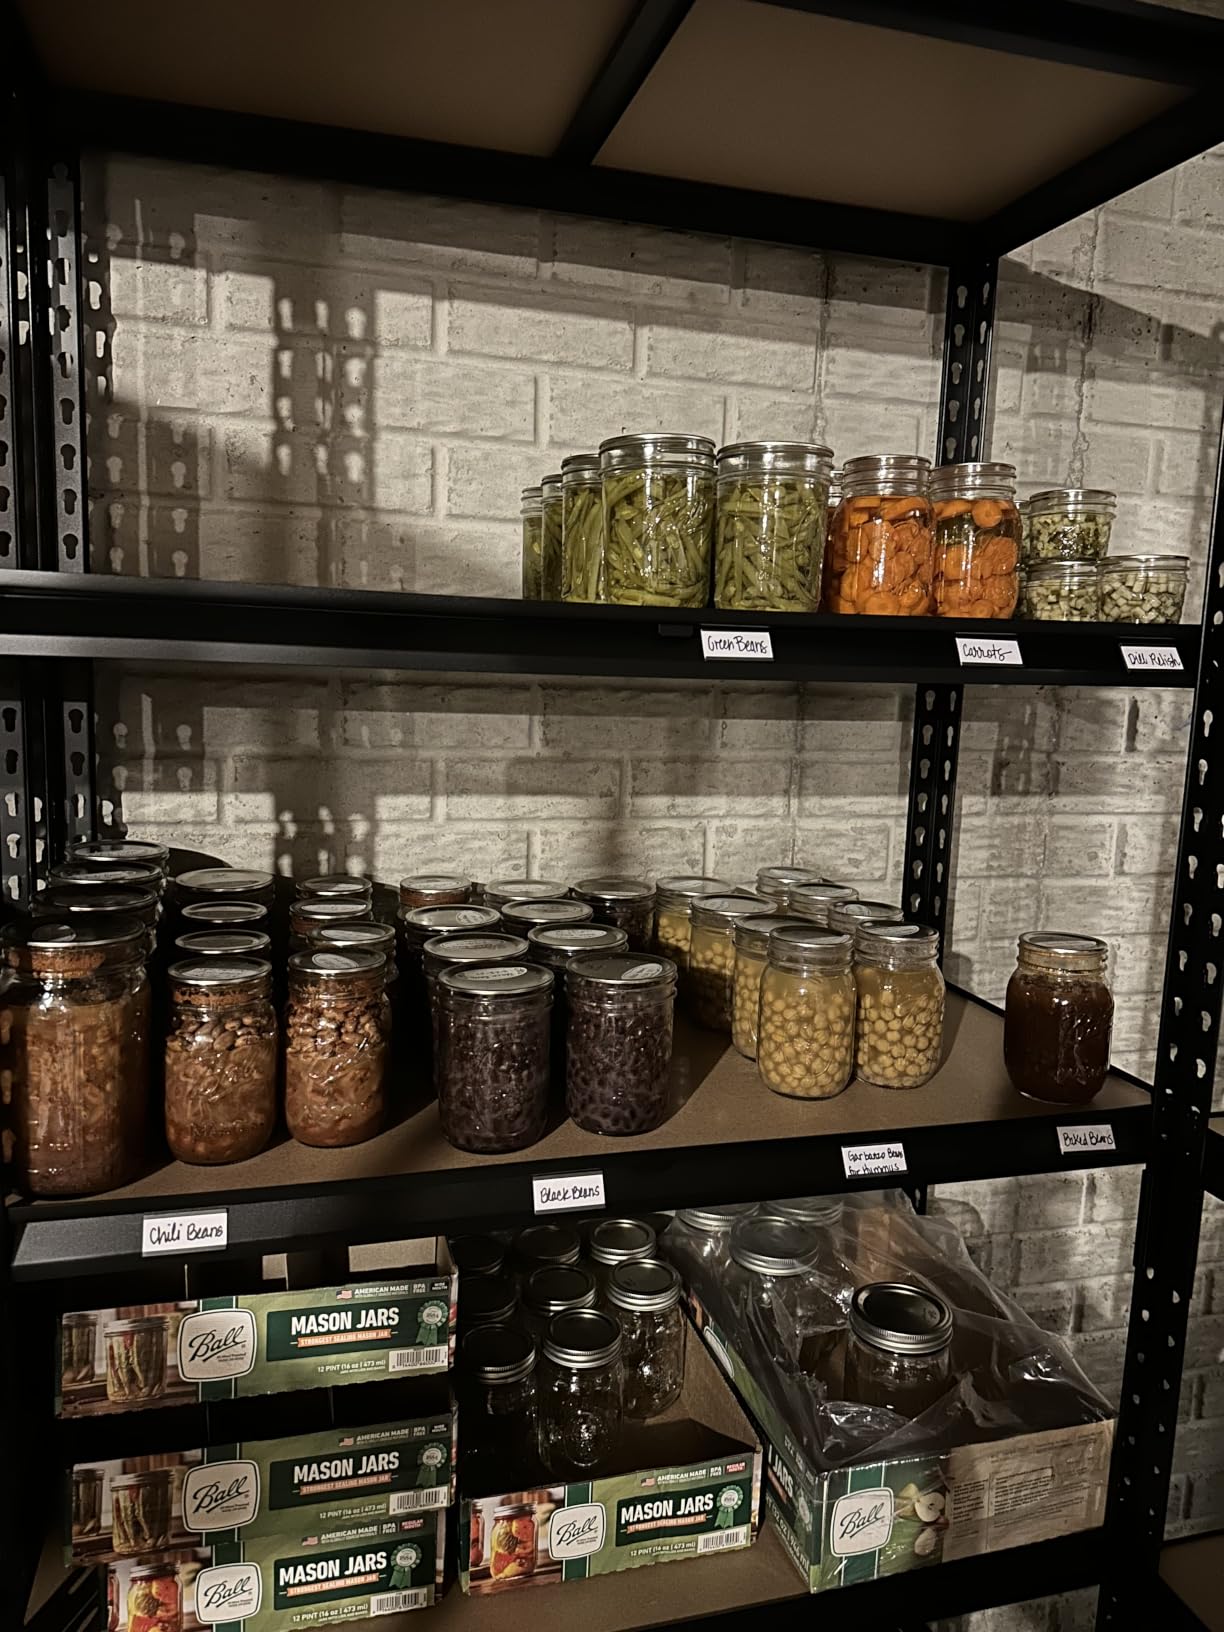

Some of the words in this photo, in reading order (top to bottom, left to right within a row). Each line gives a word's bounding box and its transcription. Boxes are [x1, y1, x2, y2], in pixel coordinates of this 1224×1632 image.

[708, 635, 735, 651] Green
[733, 635, 768, 654] Beans
[962, 643, 1013, 661] Carrots
[1128, 651, 1148, 665] Dill
[1149, 652, 1181, 668] Relish
[1062, 1132, 1089, 1147] Baked
[1088, 1130, 1114, 1146] Beans
[540, 1187, 572, 1204] Black
[571, 1185, 600, 1200] Beans
[149, 1221, 183, 1245] Chili
[186, 1222, 224, 1241] Beans
[354, 1286, 390, 1295] AMERICAN
[389, 1284, 409, 1292] MADE
[291, 1311, 352, 1335] MASON
[356, 1307, 400, 1329] JARS
[188, 1325, 247, 1363] Ball
[325, 1364, 340, 1372] PINT
[356, 1432, 390, 1441] AMERICAN
[390, 1428, 409, 1437] MADE
[293, 1458, 354, 1484] MASON
[357, 1451, 400, 1475] JARS
[657, 1472, 689, 1481] AMERICAN
[689, 1469, 707, 1477] MADE
[772, 1454, 793, 1498] JARS
[192, 1475, 250, 1514] Ball
[327, 1510, 342, 1518] PINT
[620, 1500, 673, 1524] MASON
[676, 1493, 714, 1515] JARS
[556, 1515, 598, 1546] Ball
[839, 1502, 885, 1540] Ball
[321, 1529, 357, 1540] AMERICAN
[358, 1525, 378, 1534] MADE
[638, 1547, 652, 1555] PINT
[279, 1559, 340, 1586] MASON
[344, 1551, 387, 1575] JARS
[204, 1575, 253, 1608] Ball
[301, 1612, 318, 1620] PINT
